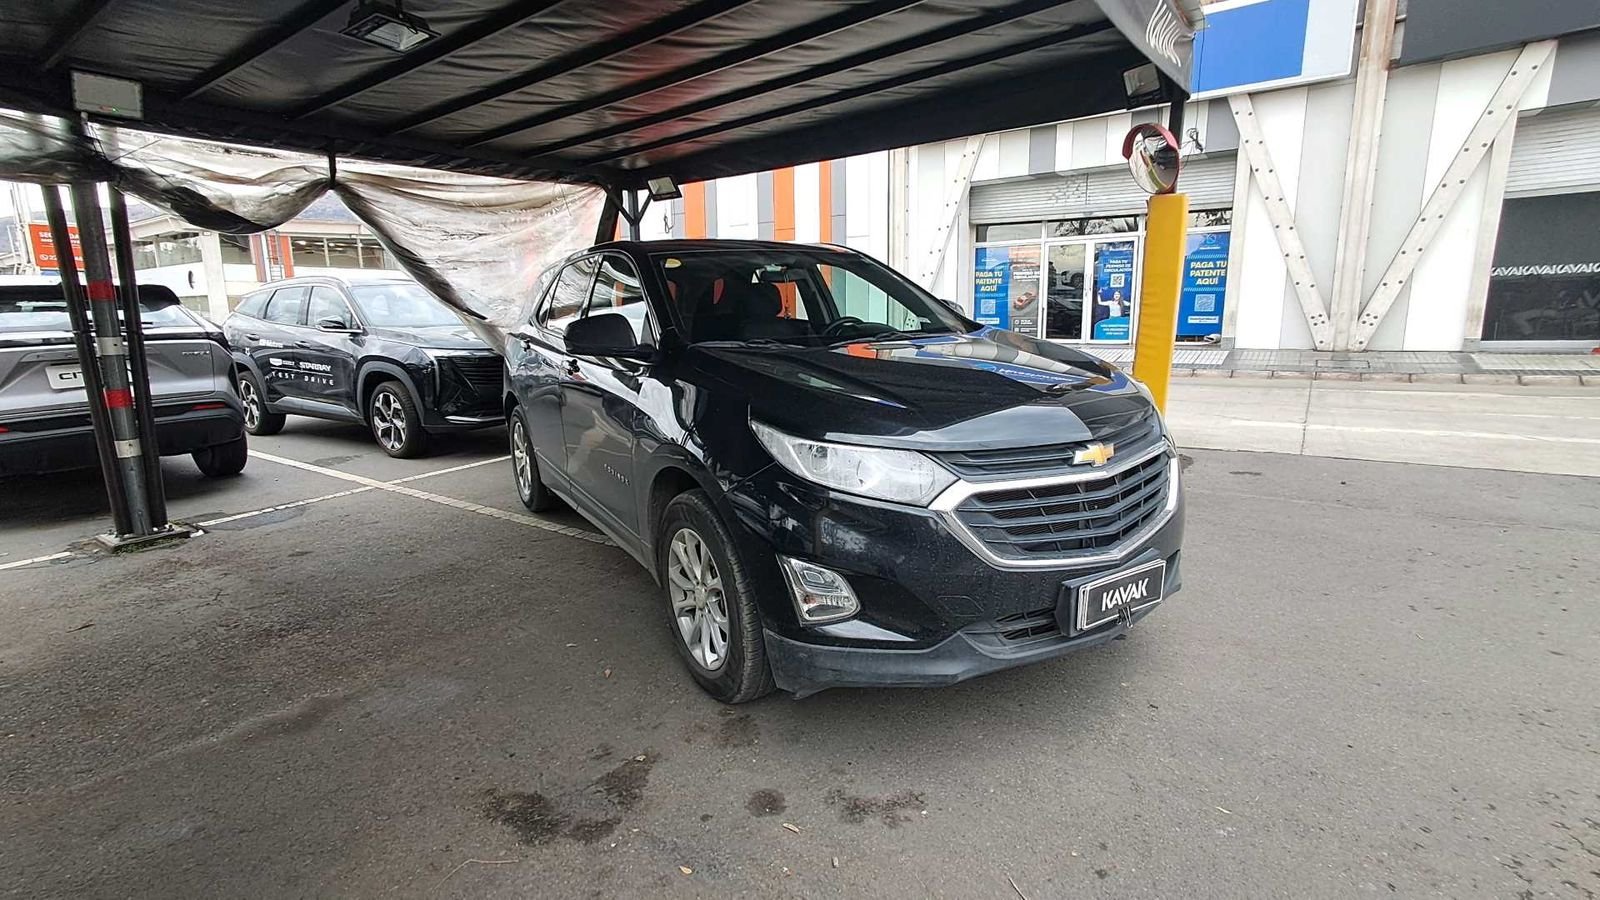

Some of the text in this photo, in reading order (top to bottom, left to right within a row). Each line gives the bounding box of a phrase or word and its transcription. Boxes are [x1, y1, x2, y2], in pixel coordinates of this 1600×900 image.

[1190, 260, 1227, 269] PAGA TU
[1189, 269, 1226, 277] PATENTE
[1195, 277, 1218, 285] AQUÍ
[272, 371, 334, 386] TEST DRIVE
[1101, 577, 1149, 612] KAVAK
